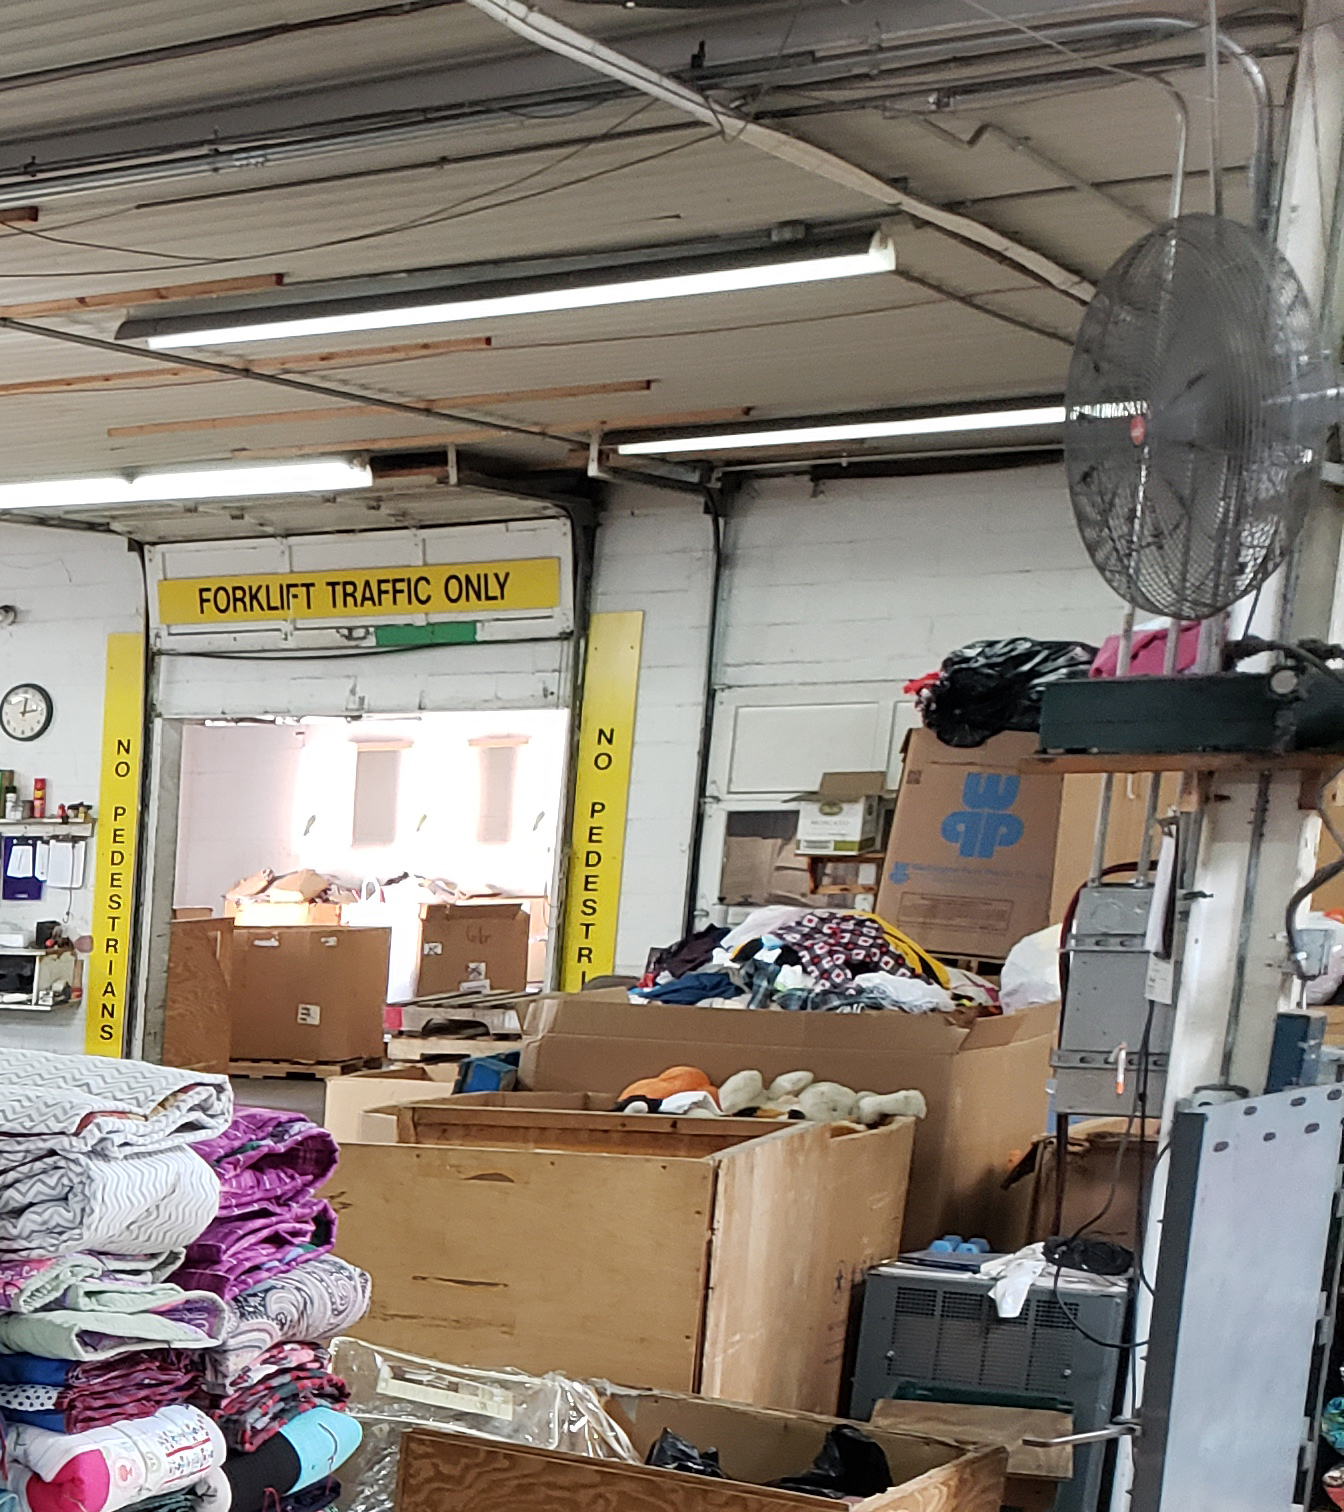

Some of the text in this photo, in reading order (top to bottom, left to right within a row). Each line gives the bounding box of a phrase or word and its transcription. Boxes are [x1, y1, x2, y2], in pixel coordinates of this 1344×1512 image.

[197, 571, 511, 615] FORKLIFT TRAFFIC ONLY
[593, 727, 616, 771] NO
[98, 738, 131, 1041] NO PEDESTRIANS
